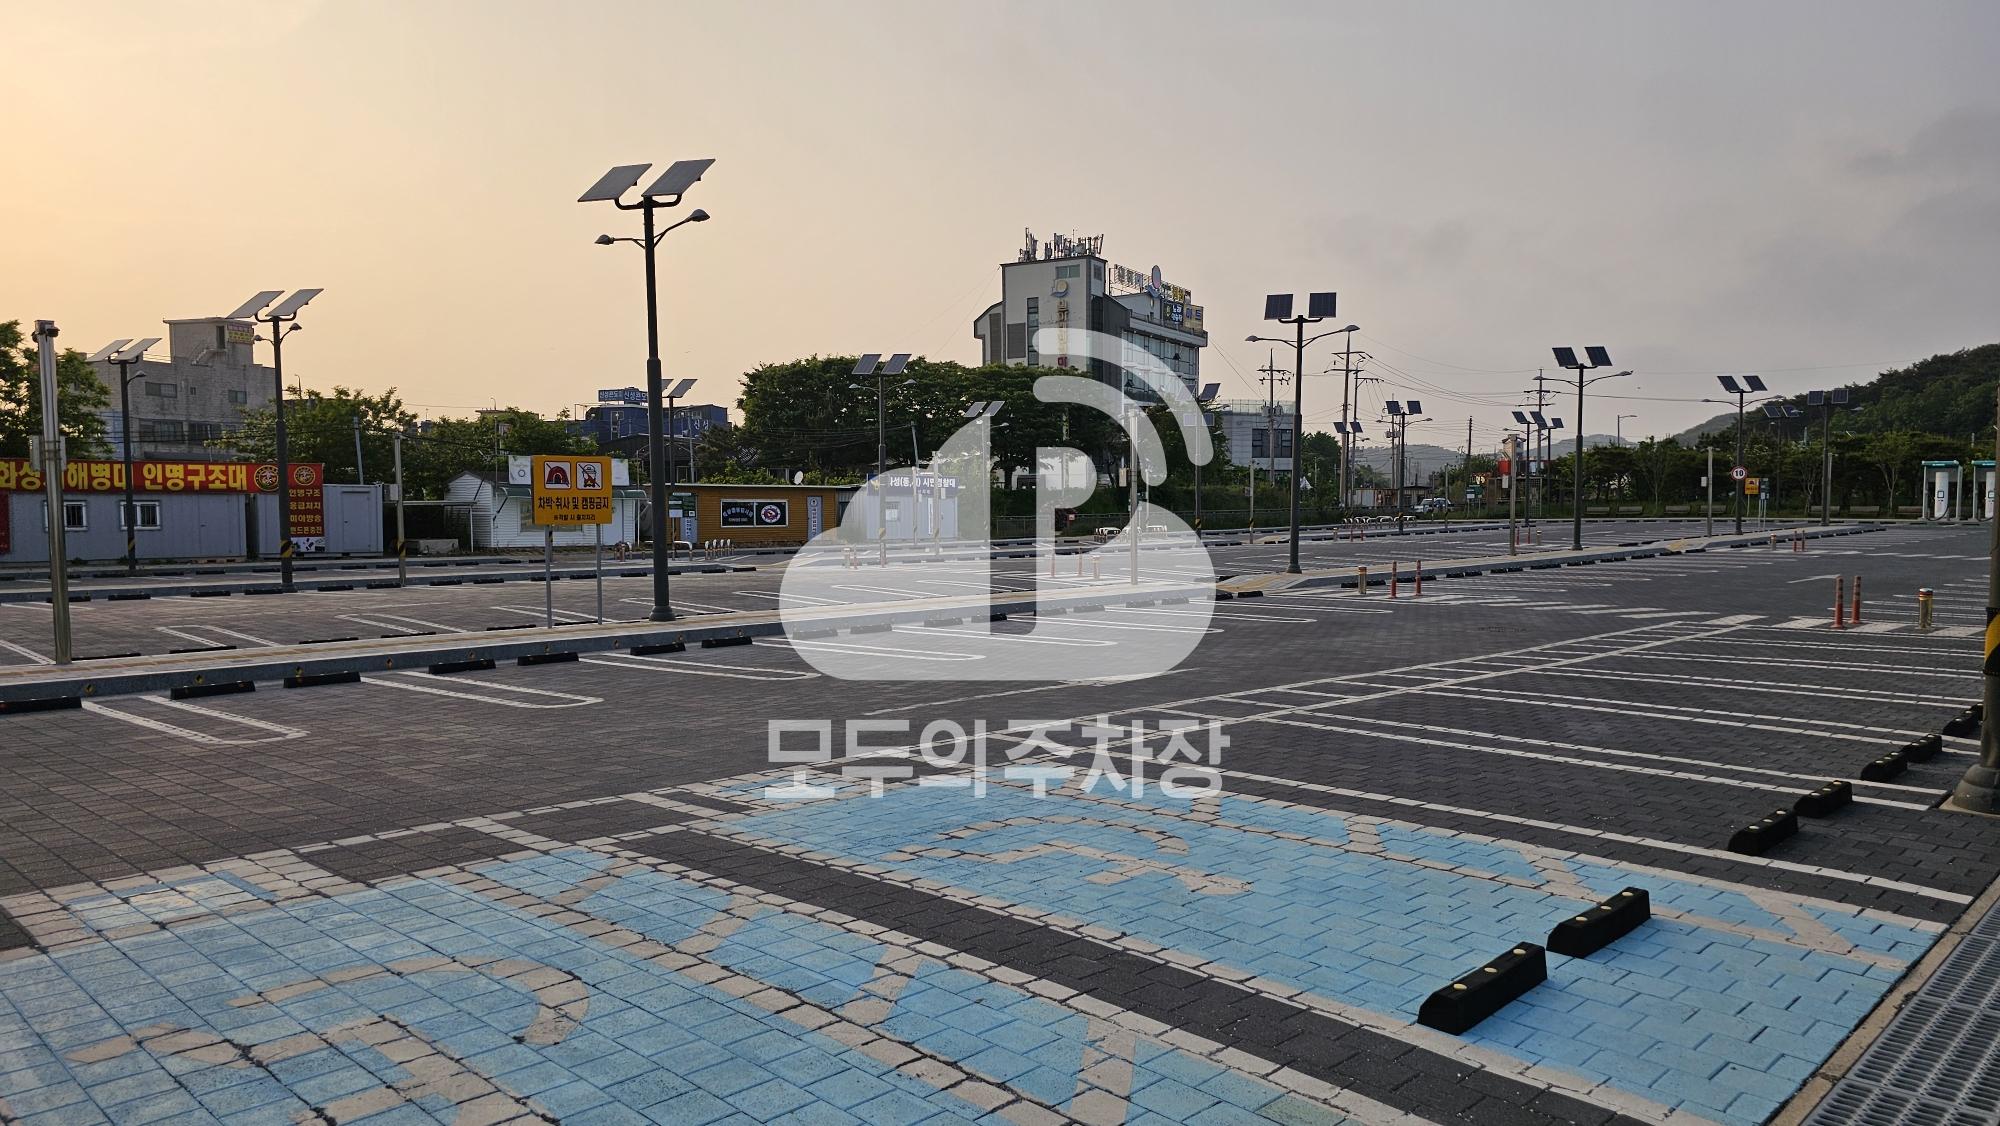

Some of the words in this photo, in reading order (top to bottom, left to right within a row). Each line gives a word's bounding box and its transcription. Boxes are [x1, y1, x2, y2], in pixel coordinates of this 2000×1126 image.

[143, 464, 248, 491] 인명구조대
[572, 496, 579, 510] 및
[581, 496, 609, 510] 캠핑금지
